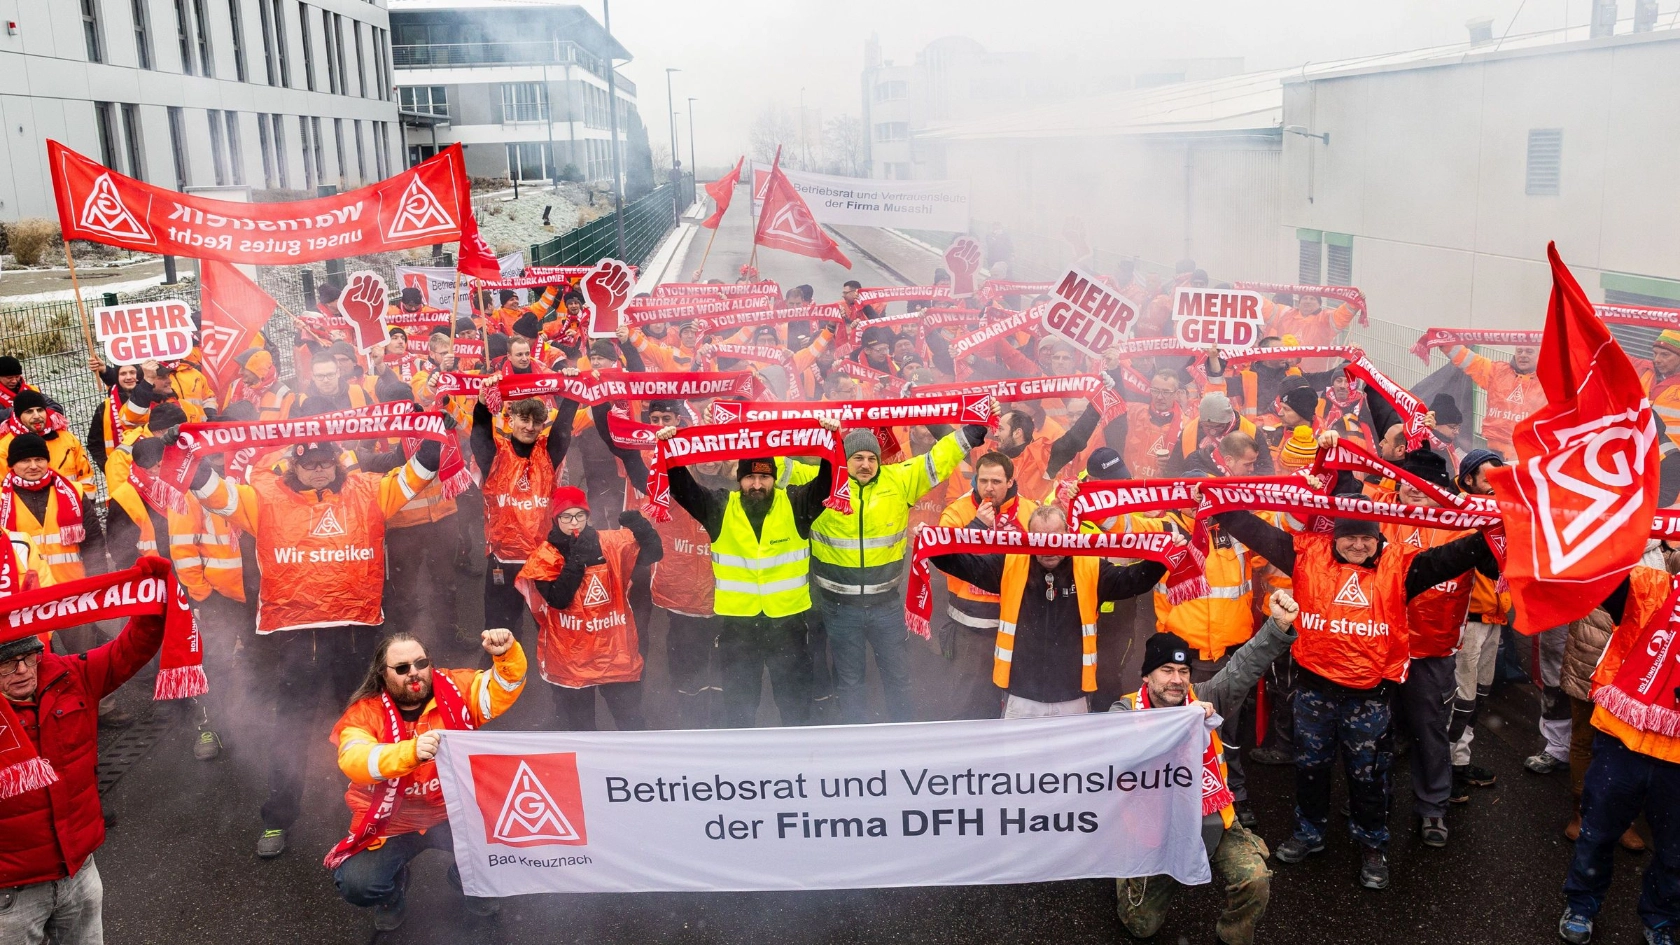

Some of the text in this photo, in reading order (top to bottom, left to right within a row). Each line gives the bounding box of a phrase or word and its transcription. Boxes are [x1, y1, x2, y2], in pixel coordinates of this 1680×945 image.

[793, 183, 966, 204] Betriebsrat und Vertrauensleute
[825, 199, 933, 214] der Firma Musashi
[633, 310, 656, 322] YOU
[659, 307, 696, 319] NEVER
[698, 303, 730, 315] WORK
[1055, 270, 1135, 334] MEHR
[1178, 292, 1259, 319] MEHR
[100, 304, 189, 336] MEHR
[711, 316, 735, 328] YOU
[736, 311, 774, 324] NEVER
[776, 306, 809, 319] WORK
[1047, 301, 1115, 355] GELD
[1181, 319, 1252, 345] GELD
[1456, 332, 1482, 342] YOU
[1484, 332, 1528, 342] NEVER
[111, 332, 188, 361] GELD
[408, 340, 429, 352] NEV
[629, 381, 679, 395] WORK
[680, 379, 735, 395] ALONE!
[1020, 376, 1101, 394] GEWINNT!
[867, 402, 958, 420] GEWINNT!
[198, 427, 252, 449] YOU
[253, 420, 323, 440] NEVER
[326, 418, 387, 437] WORK
[1209, 487, 1256, 505] YOU
[1257, 490, 1330, 510] NEVER
[1334, 496, 1406, 518] WORK
[674, 537, 693, 554] Wir
[961, 527, 1022, 547] NEVER
[1033, 530, 1091, 549] WORK
[1096, 532, 1172, 553] ALONE!
[274, 547, 305, 564] Wir
[8, 588, 101, 628] WORK
[559, 610, 627, 632] Wir streike
[1300, 611, 1326, 630] Wir
[605, 761, 1194, 803] Betriebsrat und Vertrauensleute
[704, 807, 1099, 840] der Firma DFH Haus
[488, 854, 592, 869] Bad Kreuznach
